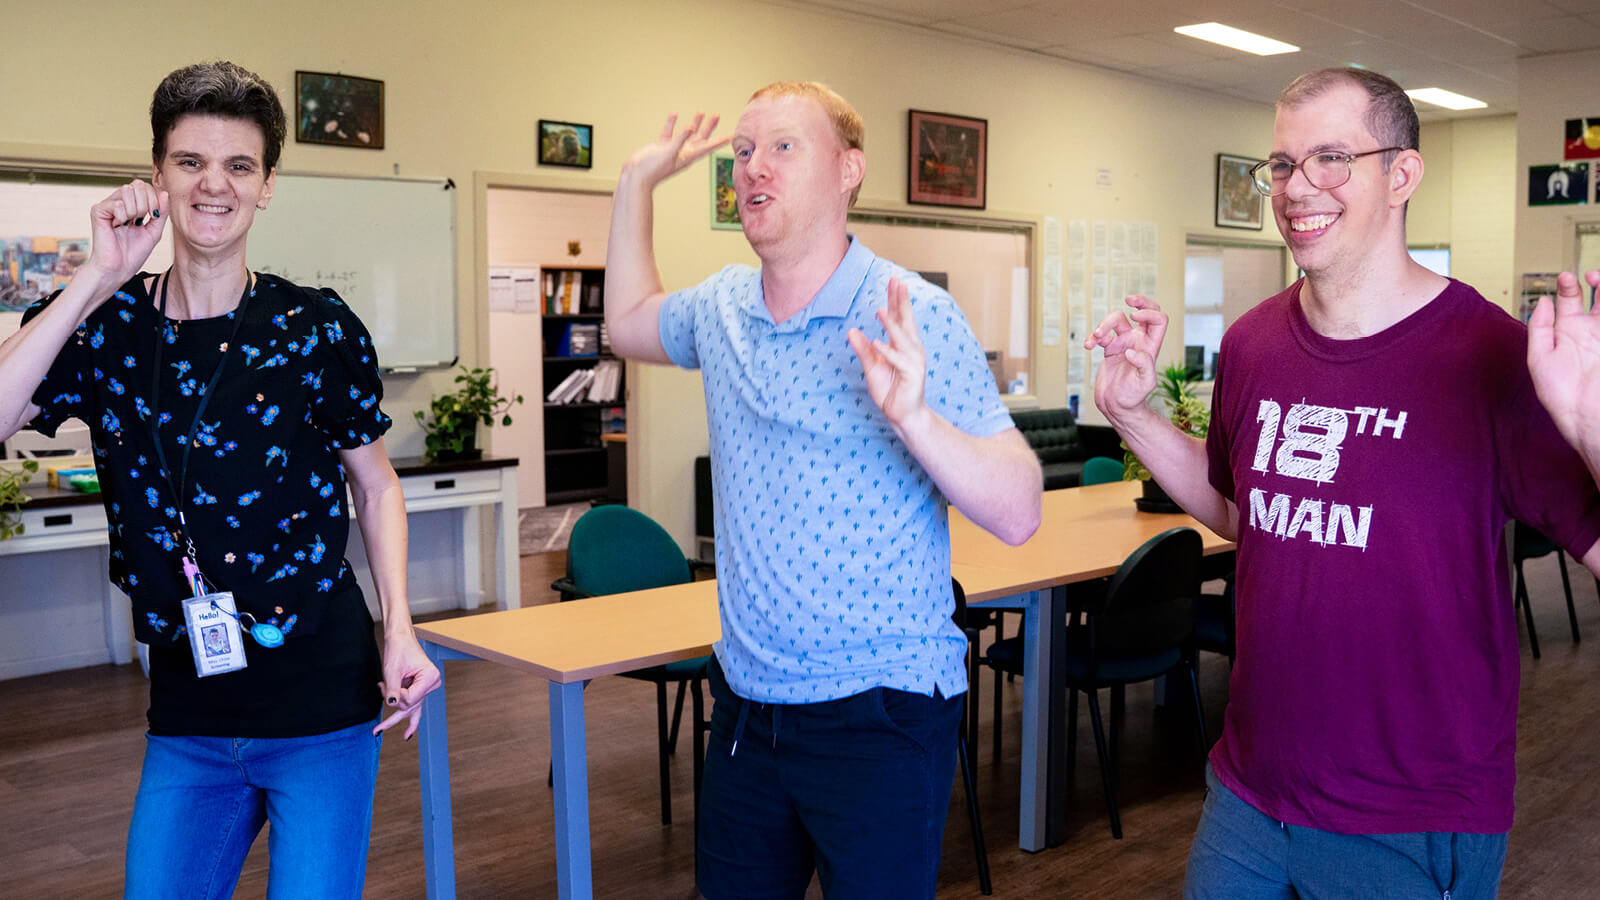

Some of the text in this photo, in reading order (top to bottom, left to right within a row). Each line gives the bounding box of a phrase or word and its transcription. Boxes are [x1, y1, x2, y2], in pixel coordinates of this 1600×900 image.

[1251, 397, 1408, 487] 18TH
[1249, 487, 1373, 552] MAN
[198, 610, 219, 621] Hello!
